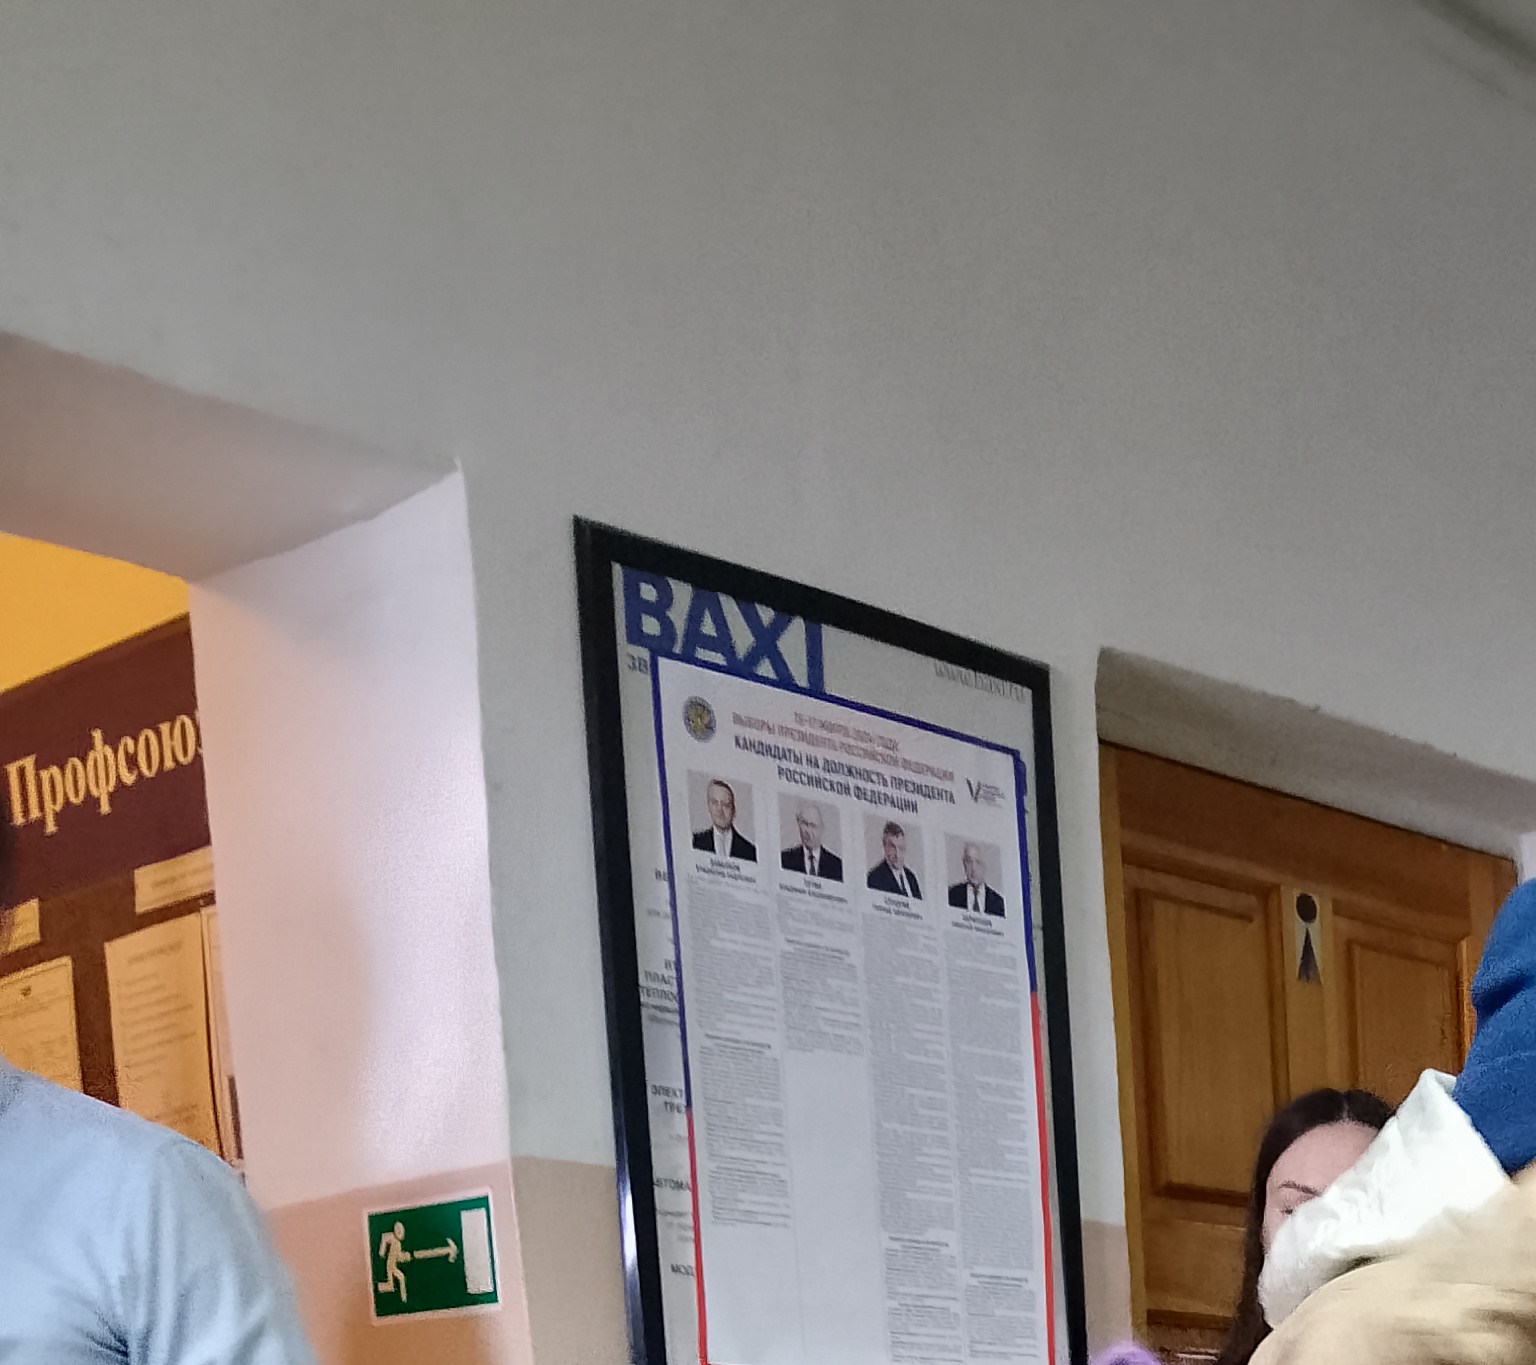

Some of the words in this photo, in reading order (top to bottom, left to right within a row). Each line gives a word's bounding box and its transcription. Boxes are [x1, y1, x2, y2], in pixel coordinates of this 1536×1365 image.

[623, 566, 825, 694] BAXI
[4, 714, 199, 836] Профсою
[734, 735, 803, 766] КАНДИДАТЫ
[805, 750, 821, 770] НА
[822, 757, 889, 788] ДОЛЖНОСТЬ
[890, 775, 956, 805] ПРЕЗИДЕНТА
